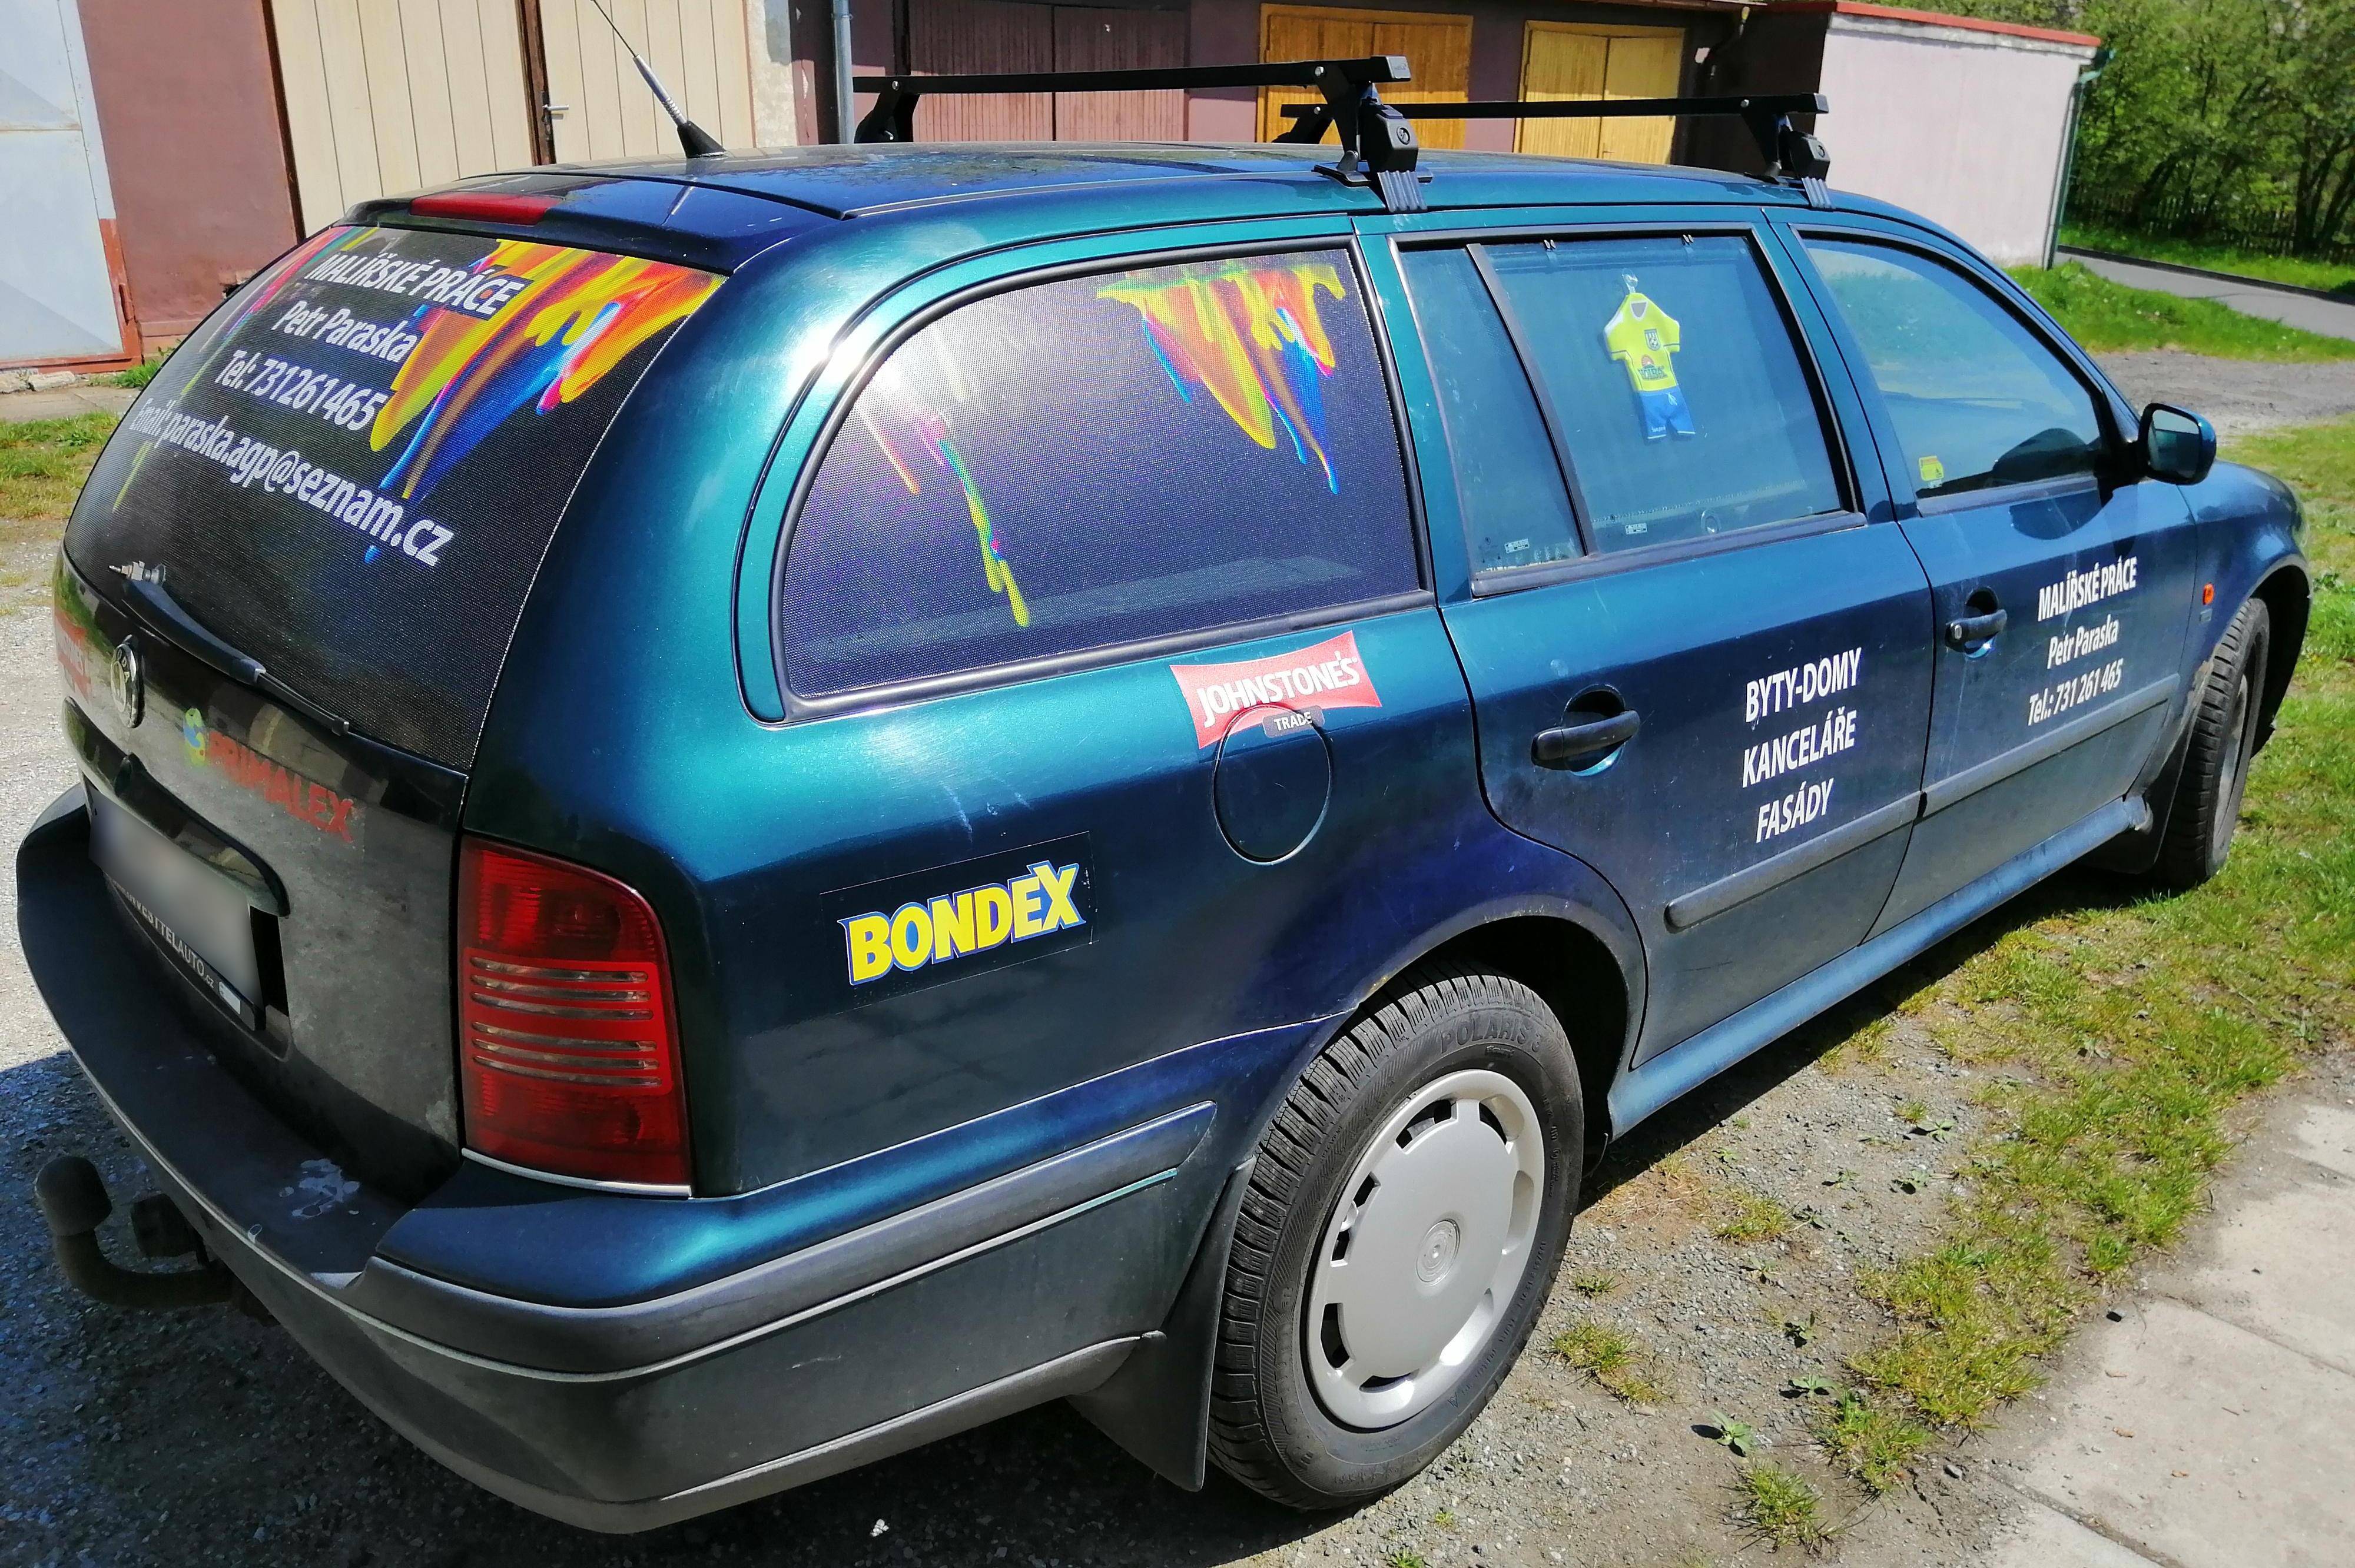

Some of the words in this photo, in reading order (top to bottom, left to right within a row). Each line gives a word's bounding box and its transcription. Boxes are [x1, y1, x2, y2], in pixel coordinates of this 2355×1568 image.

[304, 253, 440, 293] MALÍŘSKÉ
[412, 268, 525, 314] PRÁCE
[272, 300, 328, 337] Petr
[313, 308, 417, 363] Paraska
[2038, 562, 2100, 622] MALÍŘSKÉ
[2100, 556, 2137, 599] PRÁCE
[2047, 633, 2074, 669] Petr
[2074, 614, 2120, 659] Paraska
[1745, 647, 1862, 722] BYTY-DOMY
[2028, 687, 2054, 726] Tel.:
[2054, 677, 2078, 715] 731
[2077, 667, 2101, 704] 261
[2101, 657, 2124, 692] 465
[1273, 711, 1313, 732] TRADE
[1743, 706, 1856, 788] KANCELÁŘE
[1756, 778, 1834, 843] FASÁDY
[843, 862, 1084, 984] BONDEX
[1440, 1012, 1533, 1054] POLARIS
